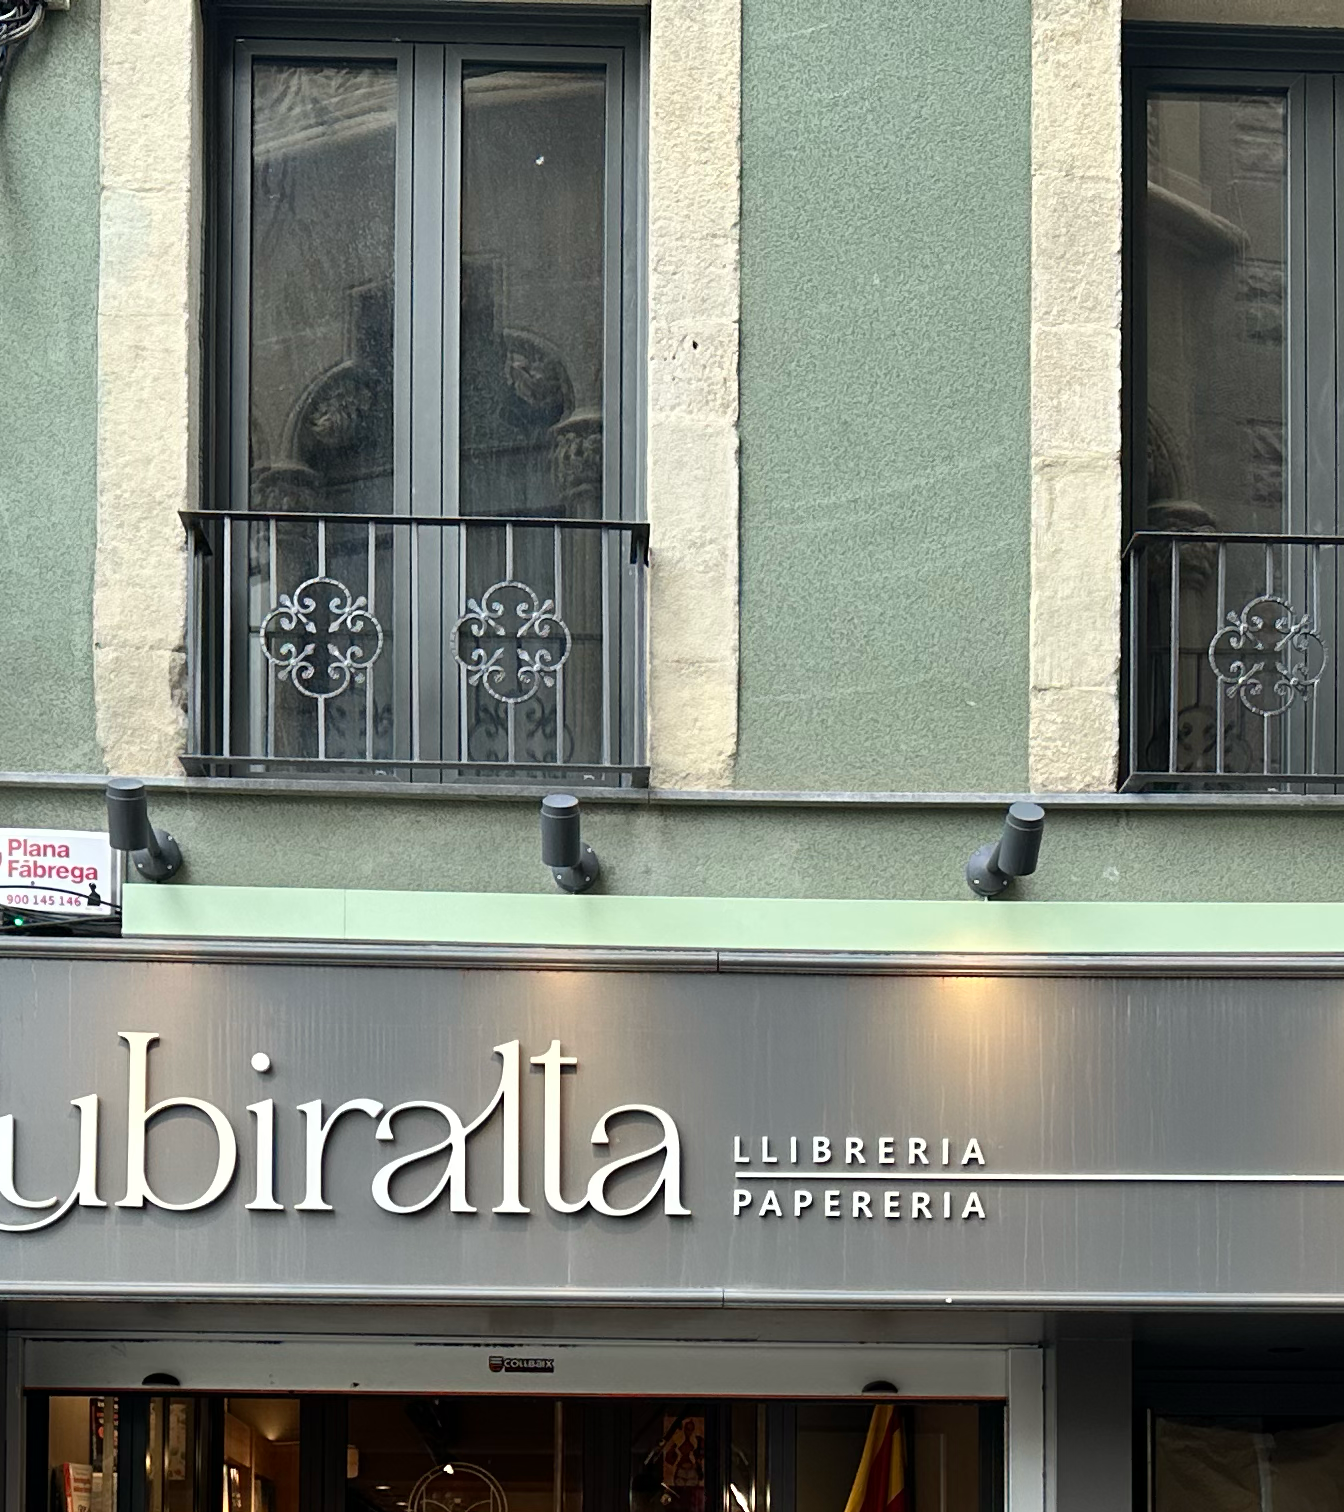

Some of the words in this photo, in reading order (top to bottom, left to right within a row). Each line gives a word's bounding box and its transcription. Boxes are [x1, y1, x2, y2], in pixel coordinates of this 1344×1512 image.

[8, 838, 71, 859] Plana
[6, 894, 30, 905] 900
[32, 894, 56, 906] 145
[58, 895, 83, 907] 146
[733, 1136, 987, 1166] LLIBRERIA
[732, 1189, 988, 1220] PAPERERIA
